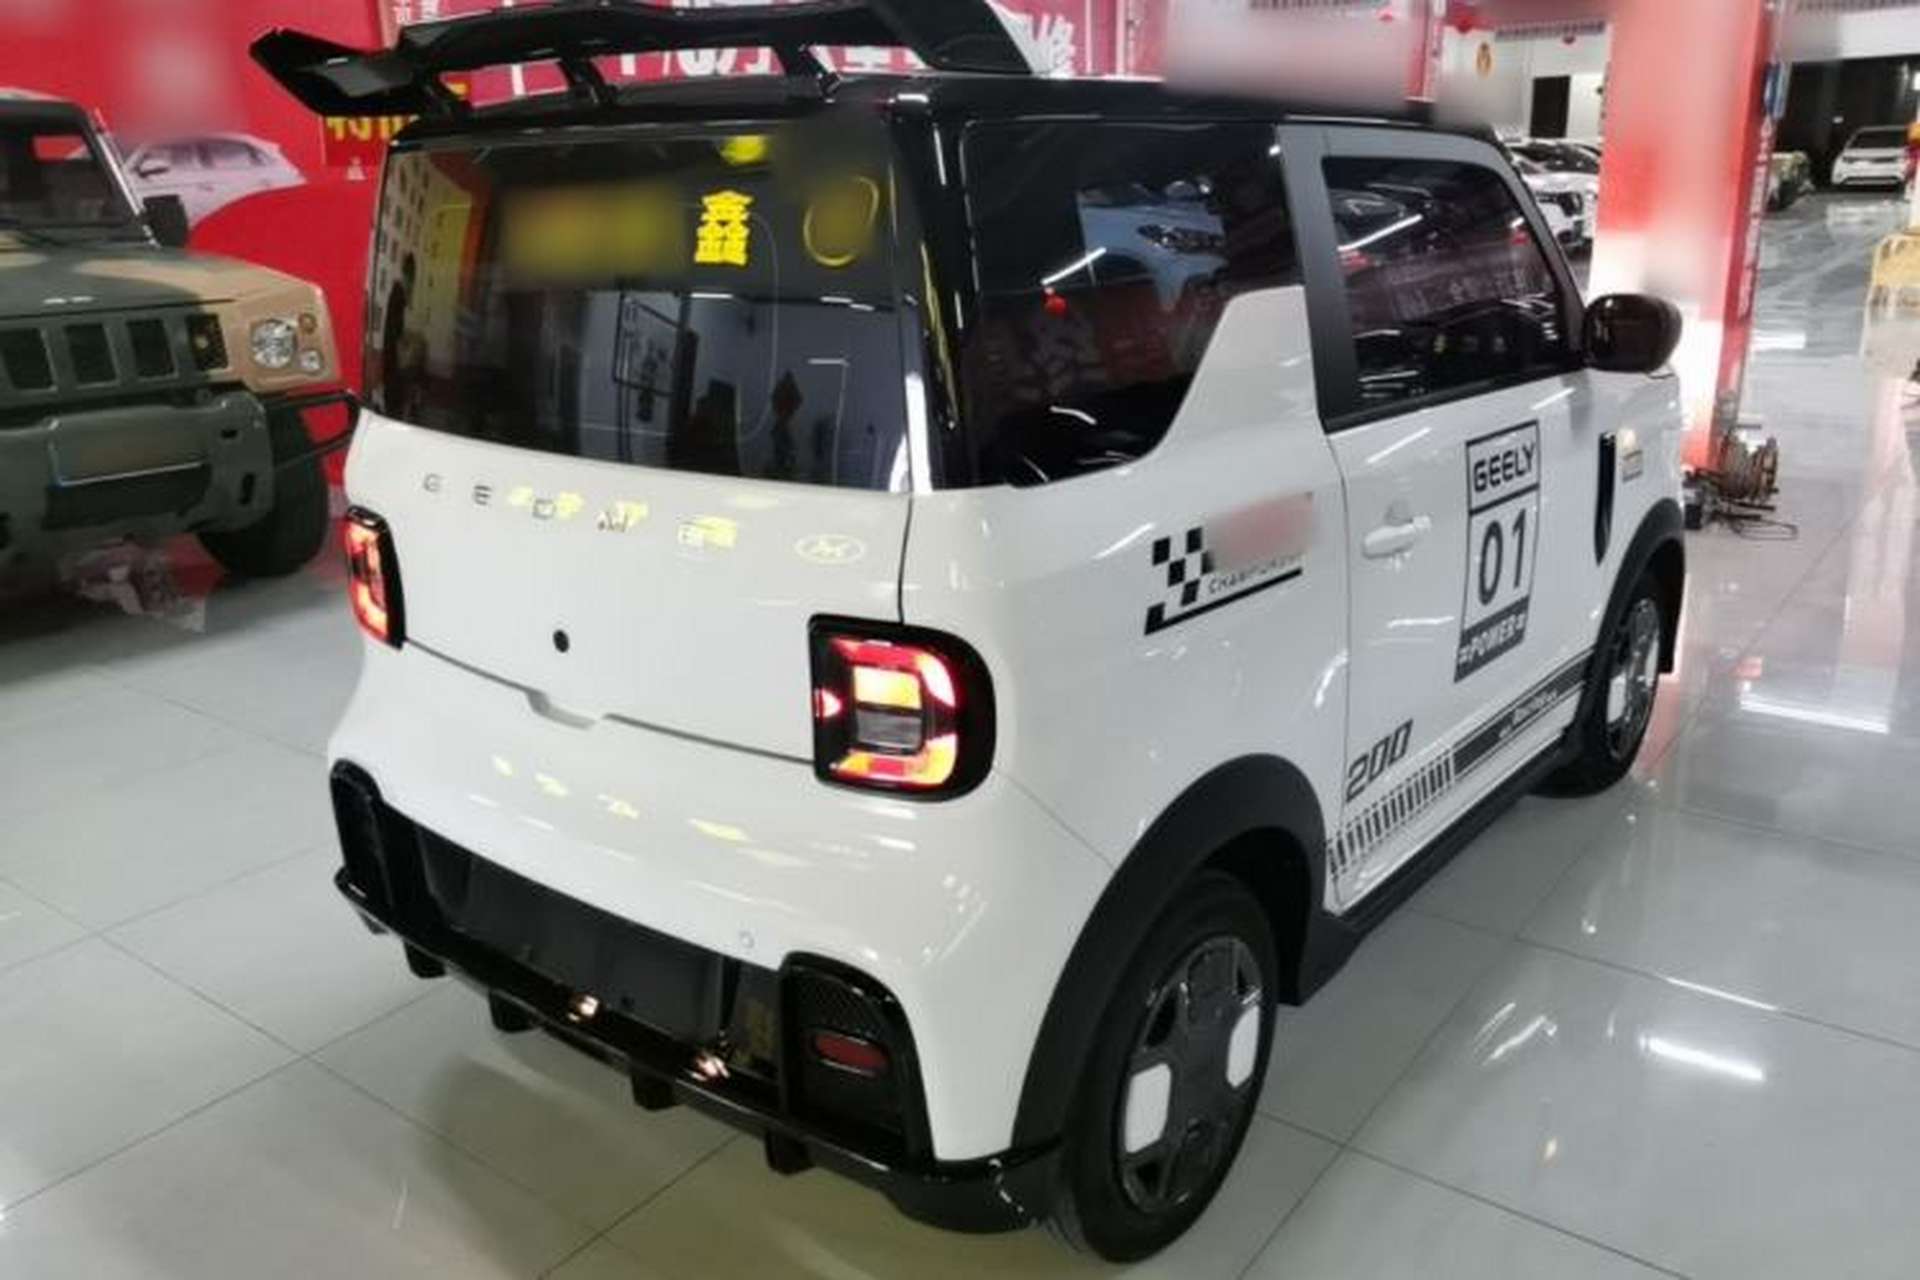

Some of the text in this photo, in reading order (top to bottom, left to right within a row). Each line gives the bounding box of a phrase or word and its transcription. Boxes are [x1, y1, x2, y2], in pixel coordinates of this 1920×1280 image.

[1473, 441, 1535, 492] GEELY
[1479, 508, 1526, 605] 01
[1346, 718, 1413, 802] 200
